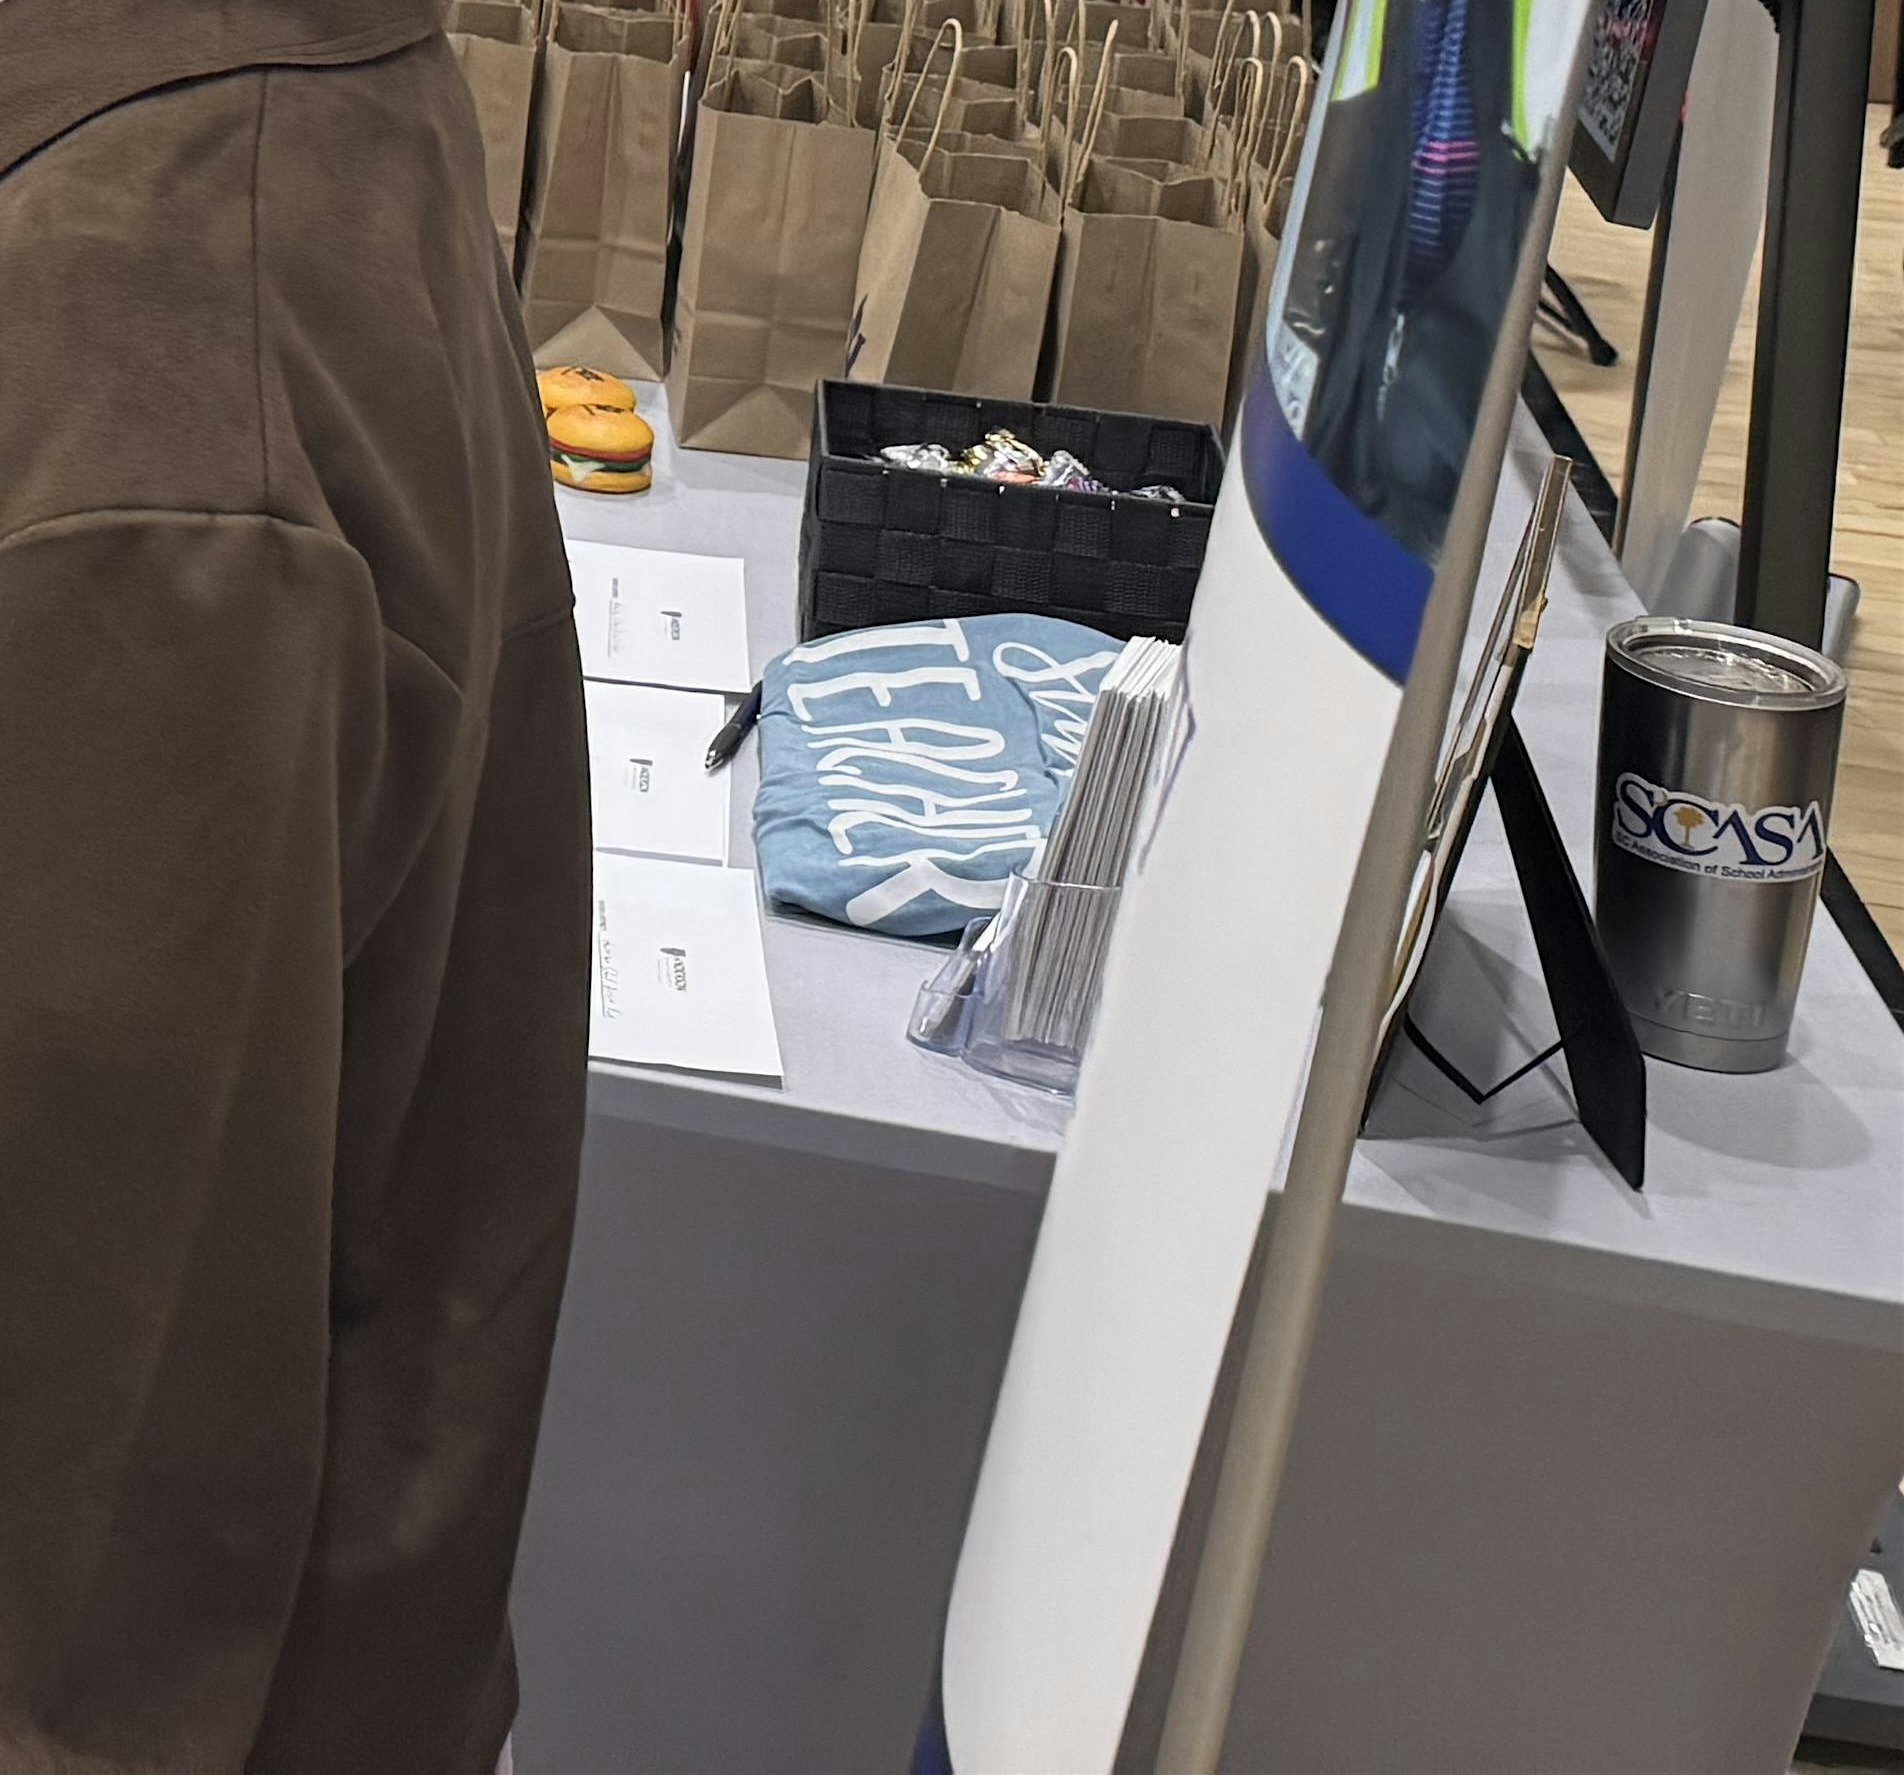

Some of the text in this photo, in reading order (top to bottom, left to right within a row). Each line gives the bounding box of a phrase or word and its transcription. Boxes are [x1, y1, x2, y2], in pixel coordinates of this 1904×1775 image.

[780, 617, 1048, 926] TEACHER
[1618, 779, 1824, 866] SCASA
[1631, 838, 1702, 872] Association
[1704, 864, 1718, 876] of
[1721, 865, 1766, 881] School
[1650, 989, 1771, 1029] YETI
